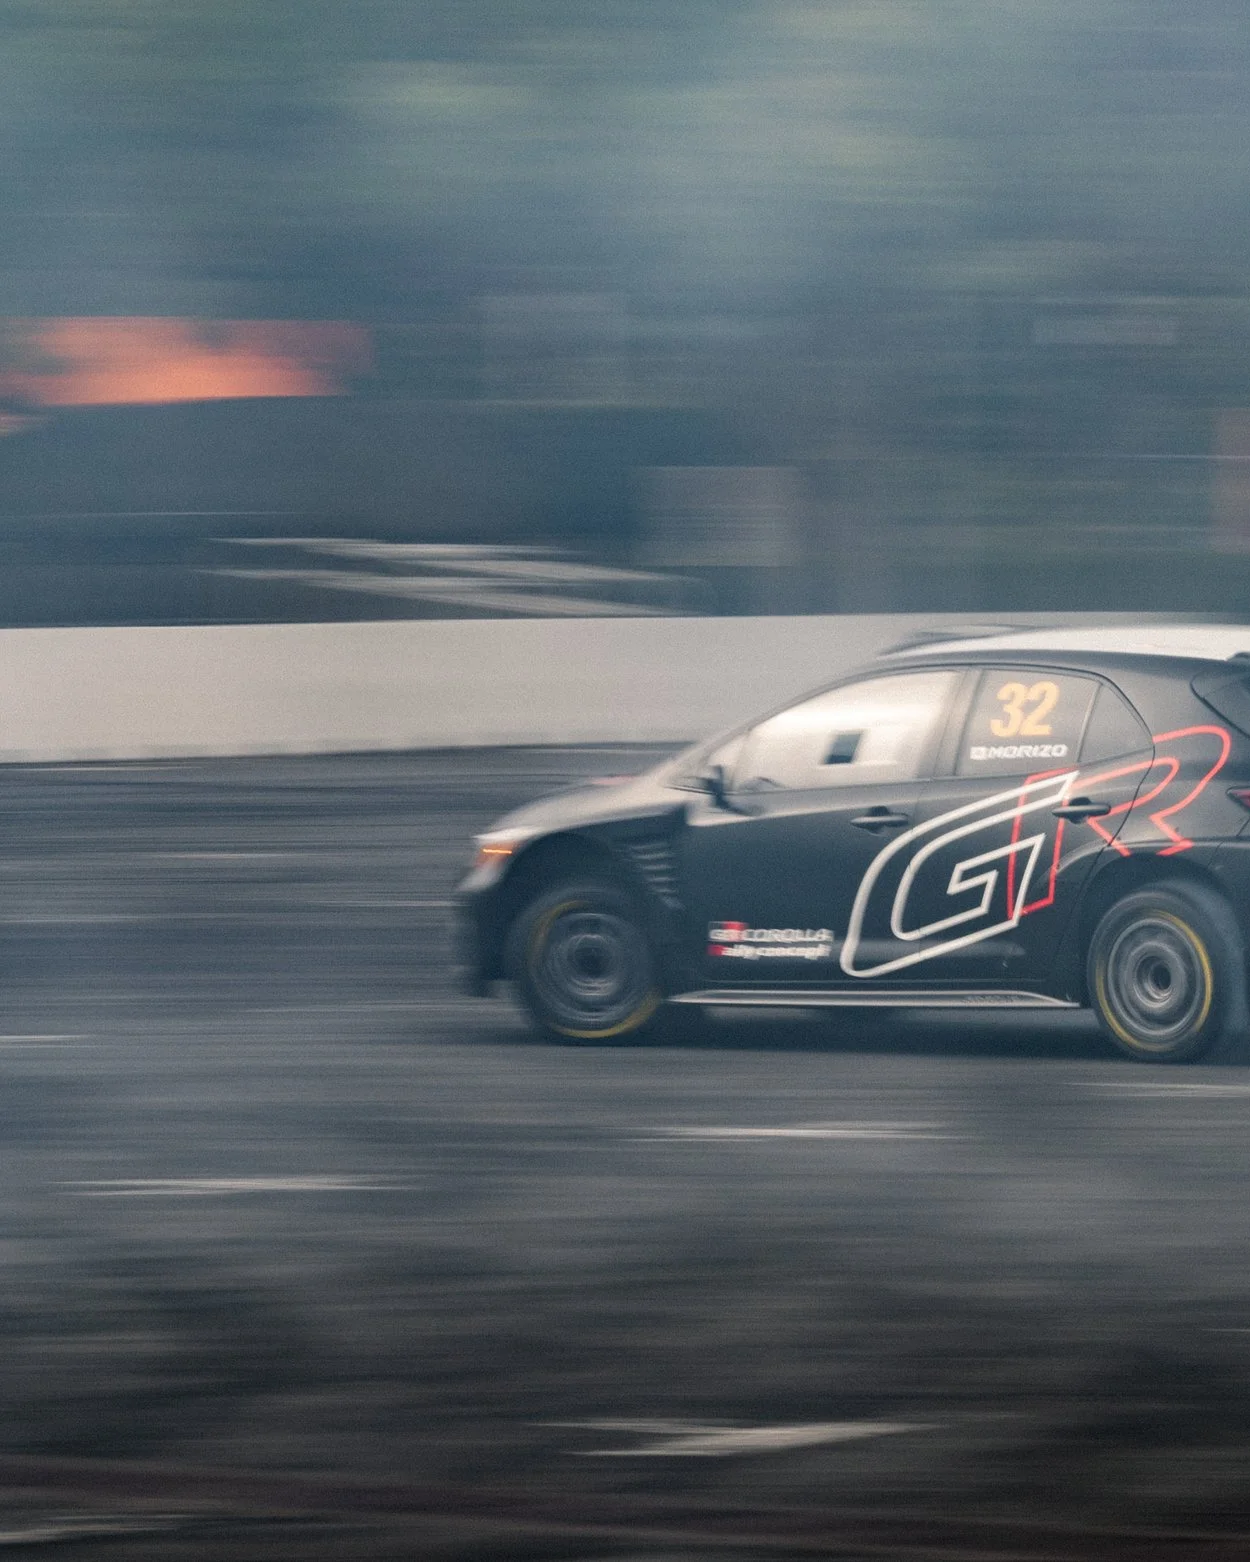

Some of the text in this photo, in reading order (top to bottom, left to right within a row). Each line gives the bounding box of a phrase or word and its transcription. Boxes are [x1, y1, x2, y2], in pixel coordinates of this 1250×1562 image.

[990, 681, 1059, 737] 32
[988, 744, 1068, 759] MORIZO
[743, 928, 834, 943] COROLLA
